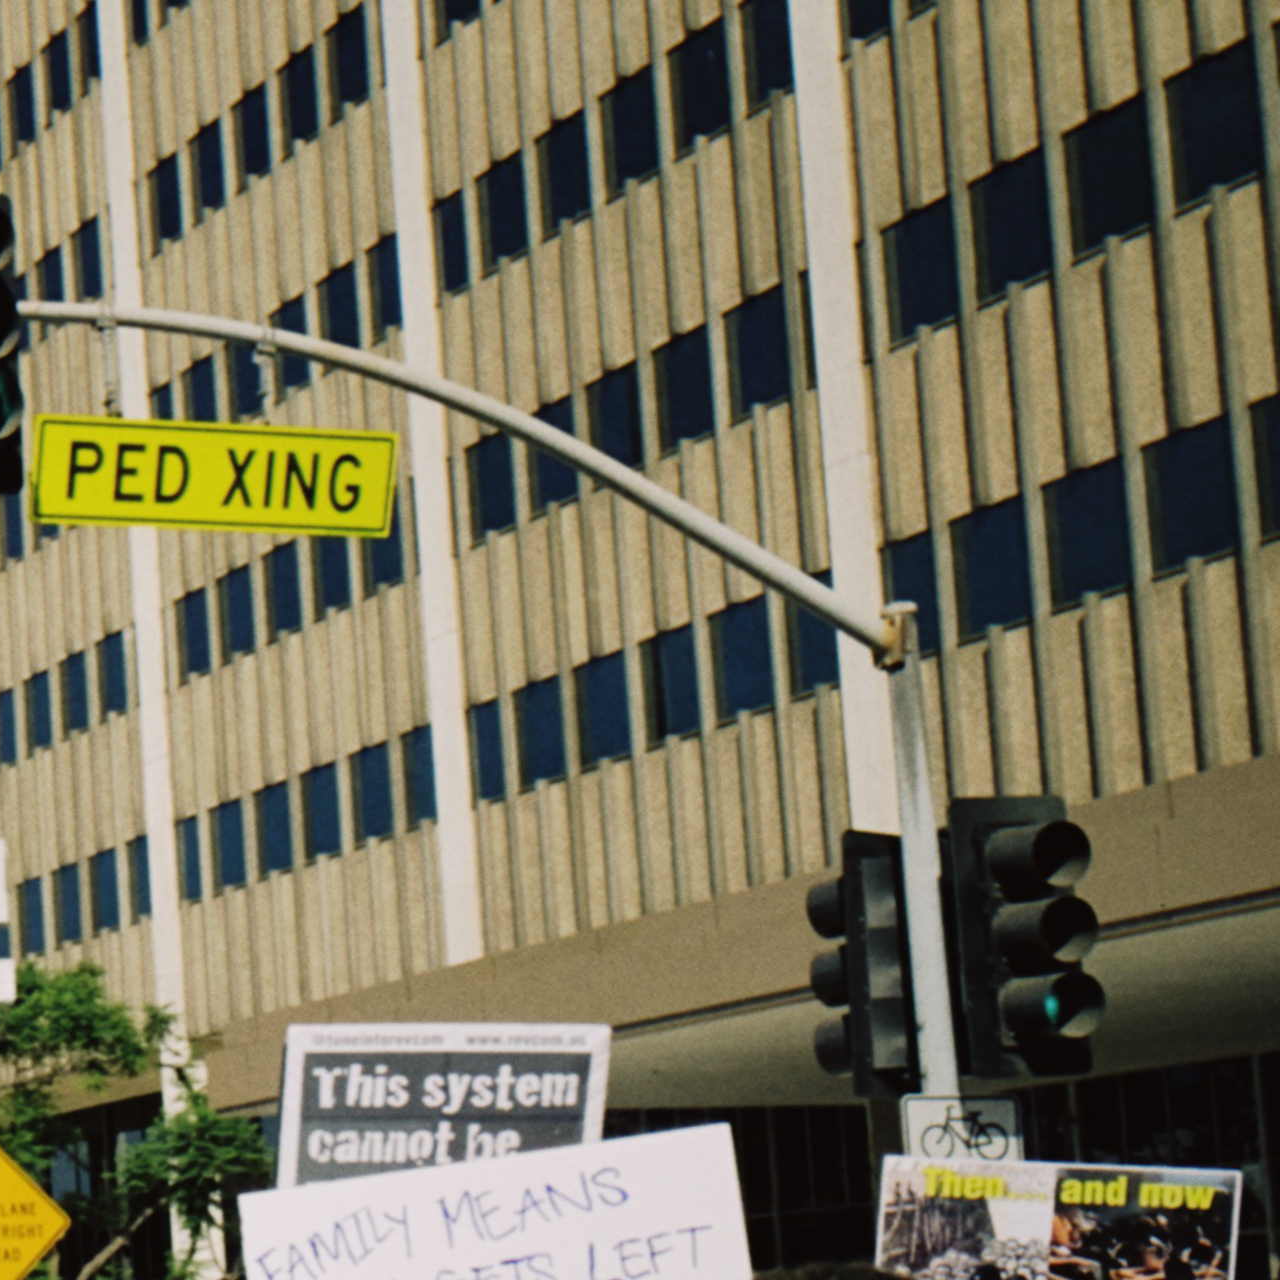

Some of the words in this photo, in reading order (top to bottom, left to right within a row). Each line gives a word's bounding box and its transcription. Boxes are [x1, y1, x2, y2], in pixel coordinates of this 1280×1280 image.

[66, 441, 190, 504] PED
[221, 448, 362, 513] XING
[312, 1063, 410, 1110] This
[422, 1063, 580, 1115] system
[307, 1120, 455, 1166] cannot
[466, 1122, 522, 1163] be
[0, 1202, 37, 1217] LANE
[438, 1166, 629, 1249] MEANS
[1060, 1175, 1129, 1207] and
[1139, 1182, 1215, 1211] now
[1, 1224, 43, 1239] RIGHT
